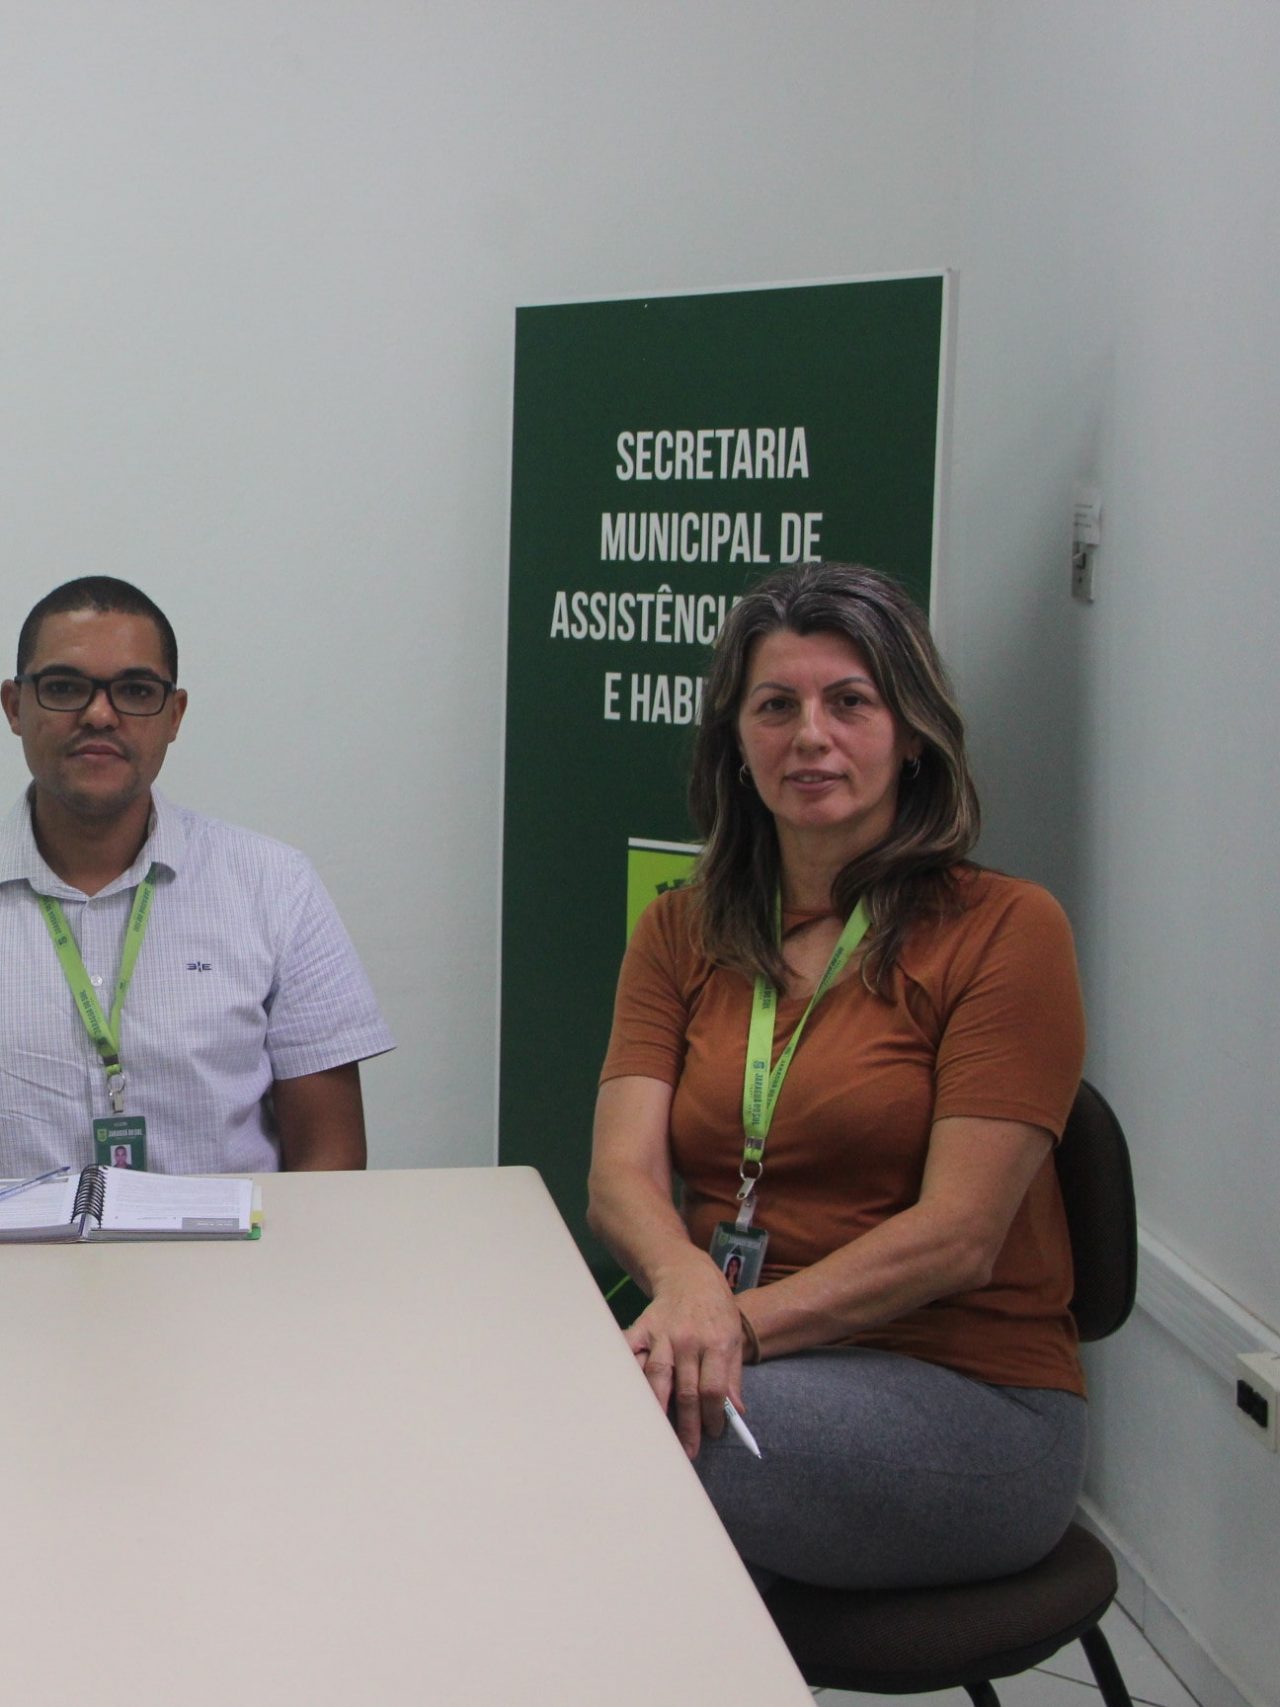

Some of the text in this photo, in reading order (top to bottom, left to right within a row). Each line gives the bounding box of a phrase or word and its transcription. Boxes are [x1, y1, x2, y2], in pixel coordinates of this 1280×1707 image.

[615, 427, 809, 481] SECRETARIA
[600, 512, 823, 563] MUNICIPAL DE
[550, 584, 744, 646] ASSISTÊNCI
[603, 672, 703, 727] E HABI
